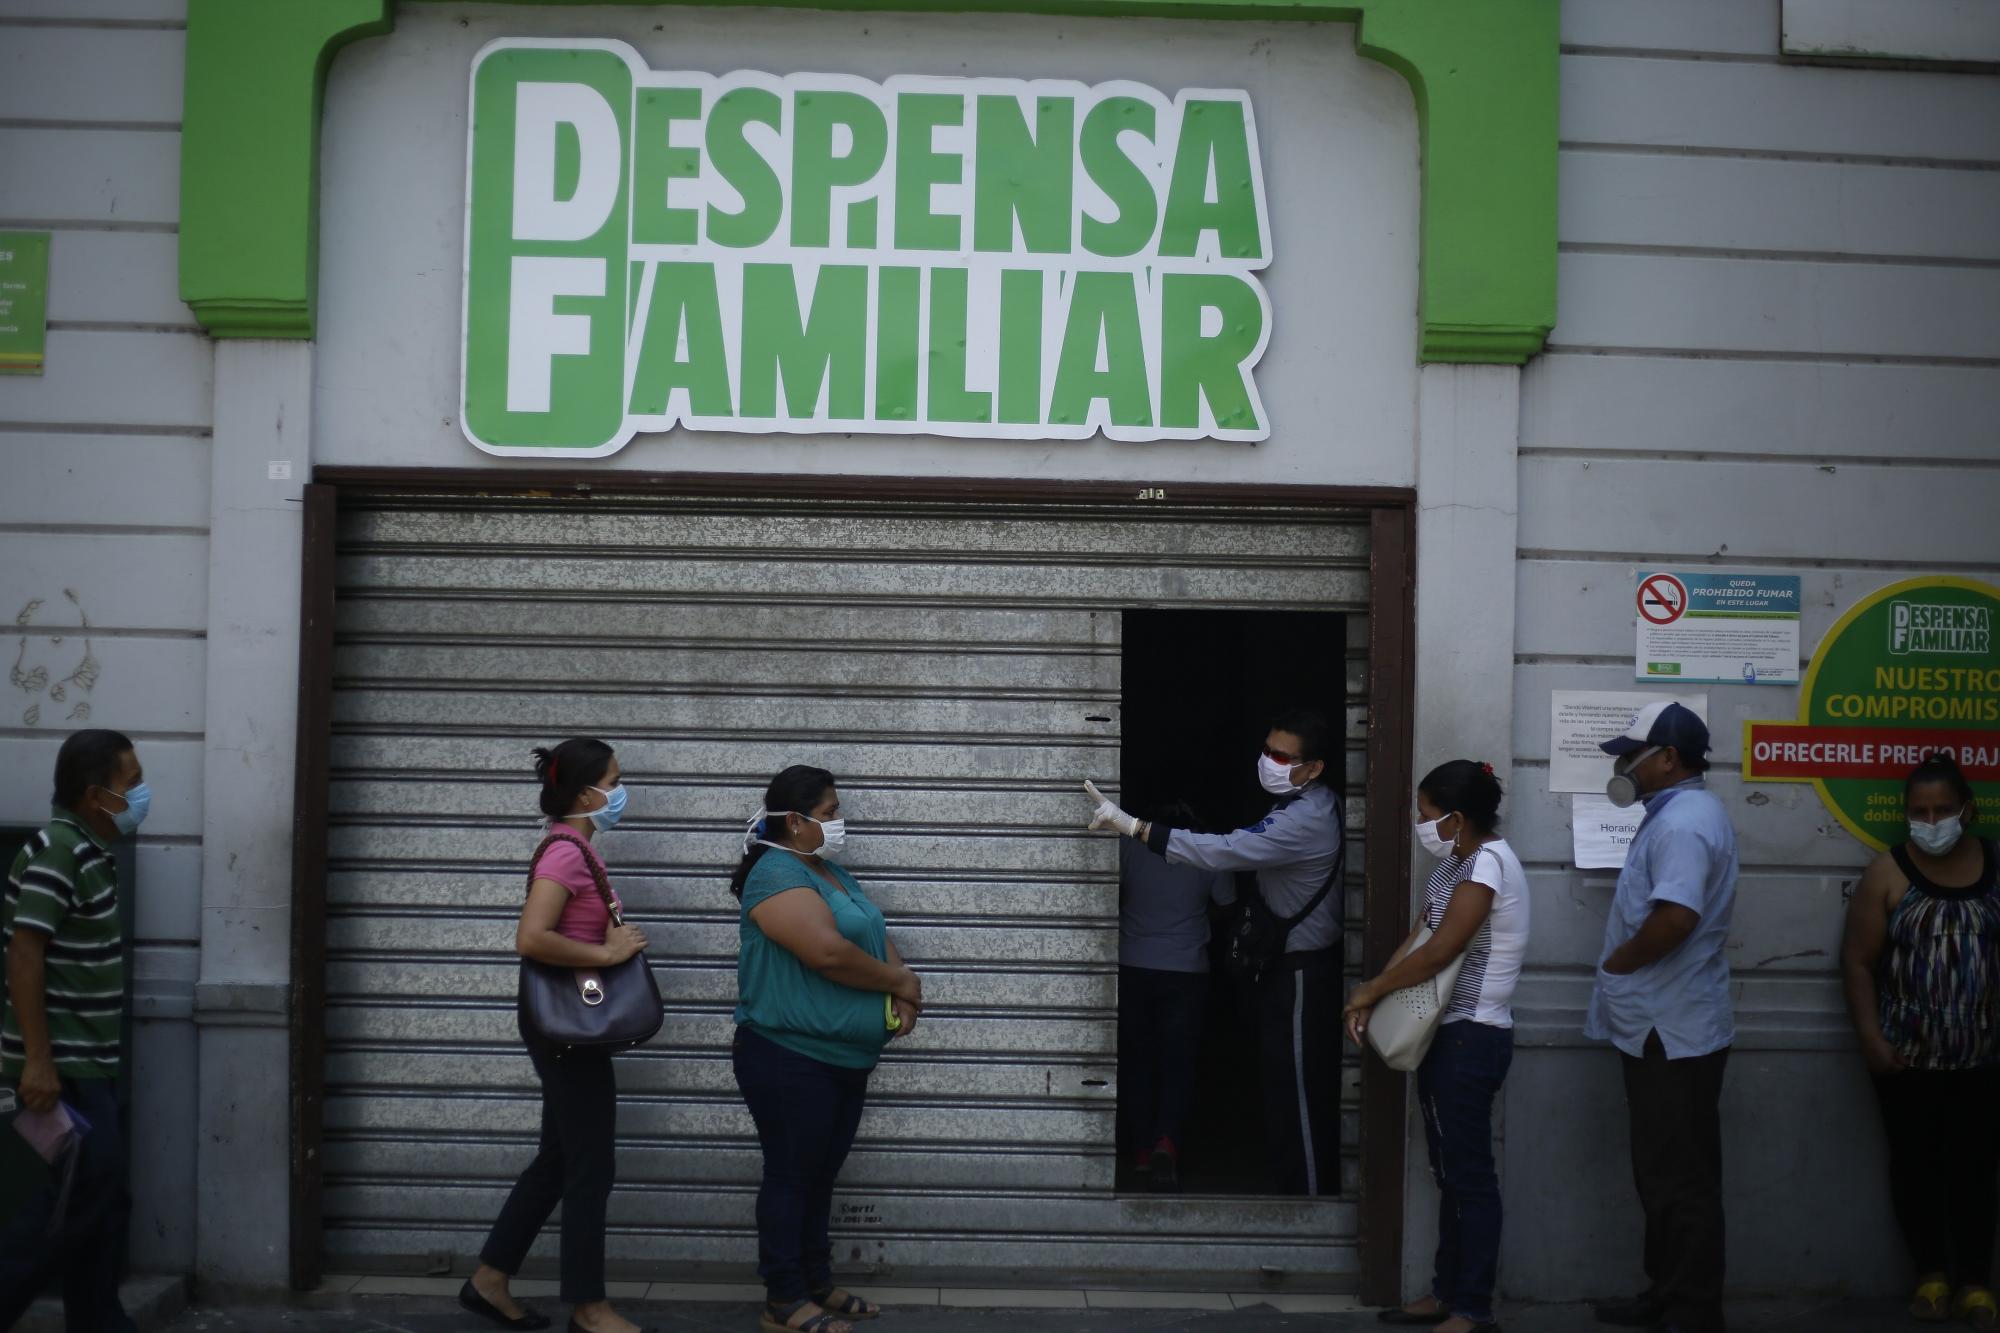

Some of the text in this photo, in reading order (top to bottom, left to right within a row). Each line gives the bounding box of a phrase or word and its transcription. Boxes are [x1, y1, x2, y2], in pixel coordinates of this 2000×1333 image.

[510, 81, 1264, 260] DESPENSA
[505, 256, 1262, 431] FAMILIAR
[1692, 588, 1793, 598] PROHIBIDO FUMAR
[1894, 605, 1988, 630] DESPENSA
[1894, 628, 1988, 652] FAMILIAR
[1875, 666, 2000, 692] NUESTRO
[1825, 694, 2000, 721] COMPROMIS
[1754, 741, 1874, 764] OFRECERLE
[1866, 792, 1896, 805] sino
[1864, 809, 1904, 822] doble
[1600, 823, 1638, 833] Horario
[1610, 836, 1633, 844] Tien
